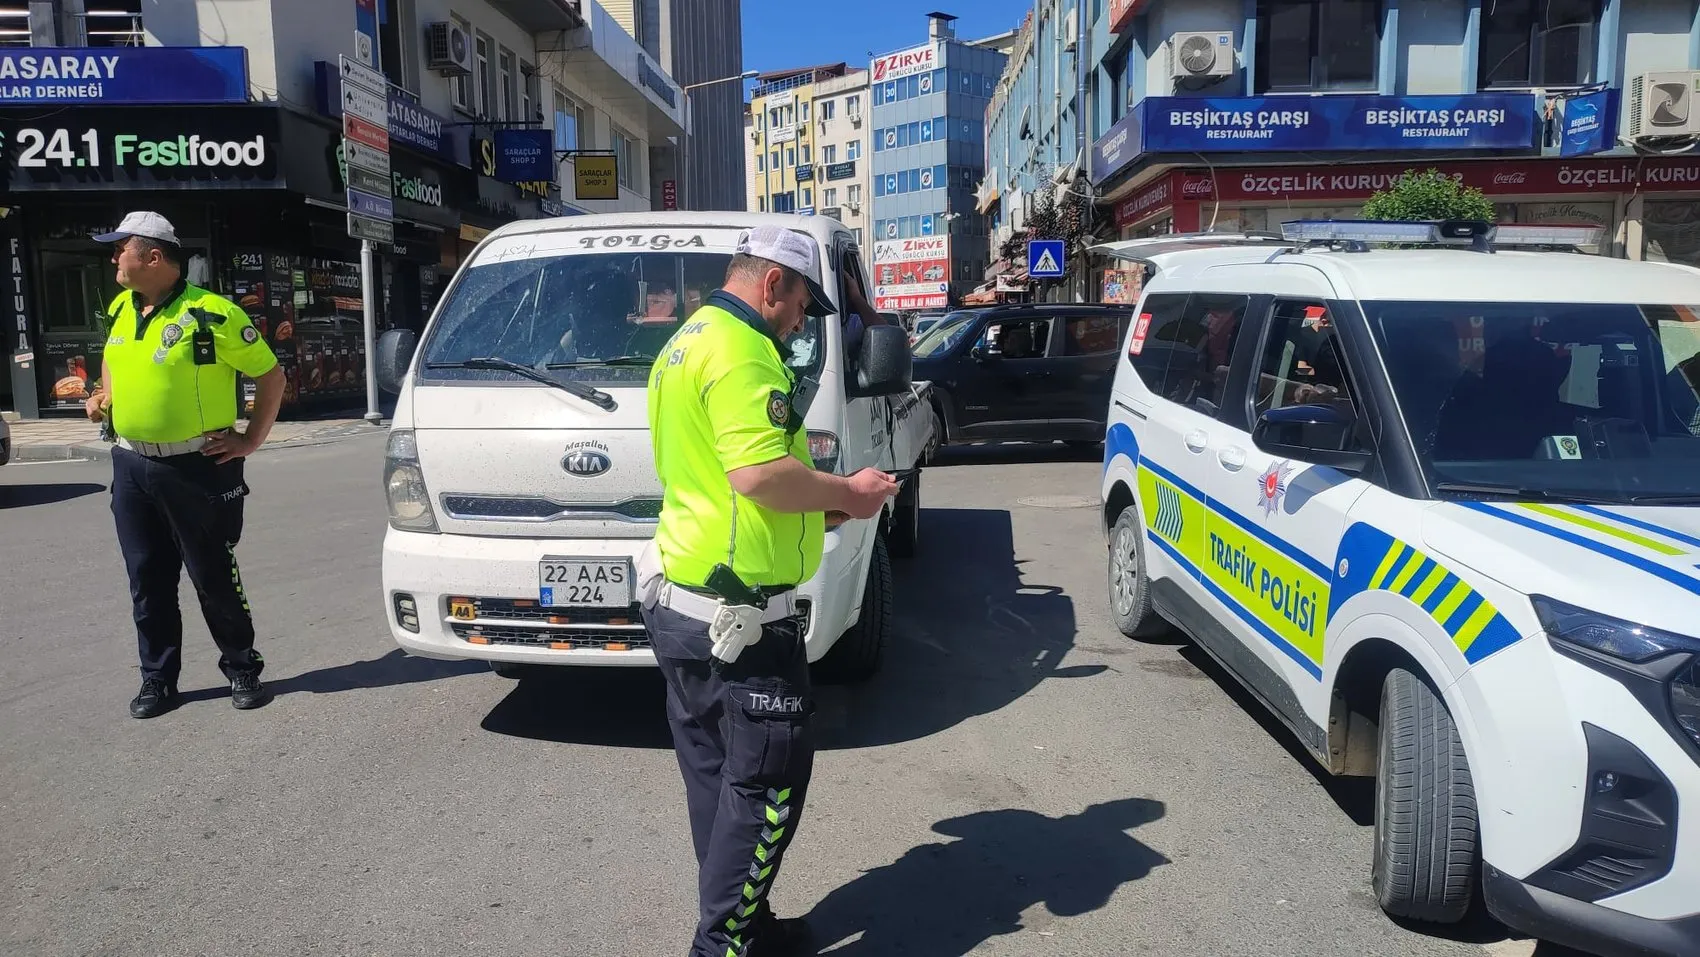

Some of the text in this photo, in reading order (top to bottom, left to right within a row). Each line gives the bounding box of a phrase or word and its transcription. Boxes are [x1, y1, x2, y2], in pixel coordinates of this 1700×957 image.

[888, 49, 933, 71] ZİRVE
[0, 83, 103, 98] LAR DERNEĞİ
[1170, 108, 1309, 129] BEŞİKTAŞ ÇARŞI
[1366, 107, 1505, 127] BEŞİKTAŞ ÇARŞI
[1206, 130, 1274, 139] RESTAURANT
[1402, 128, 1470, 137] RESTAURANT
[16, 128, 265, 167] 24.1 Fastfood
[505, 148, 542, 159] SARAÇLAR
[579, 169, 612, 179] SARAÇLAR
[1241, 172, 1326, 195] ÖZÇELİK
[579, 234, 706, 250] TOLGA
[241, 253, 263, 265] 24.1
[564, 439, 609, 452] Maşallah
[569, 456, 603, 471] KIA
[545, 565, 624, 583] 22 AAS
[1210, 532, 1317, 638] TRAFİK POLİSİ
[569, 585, 604, 603] 224
